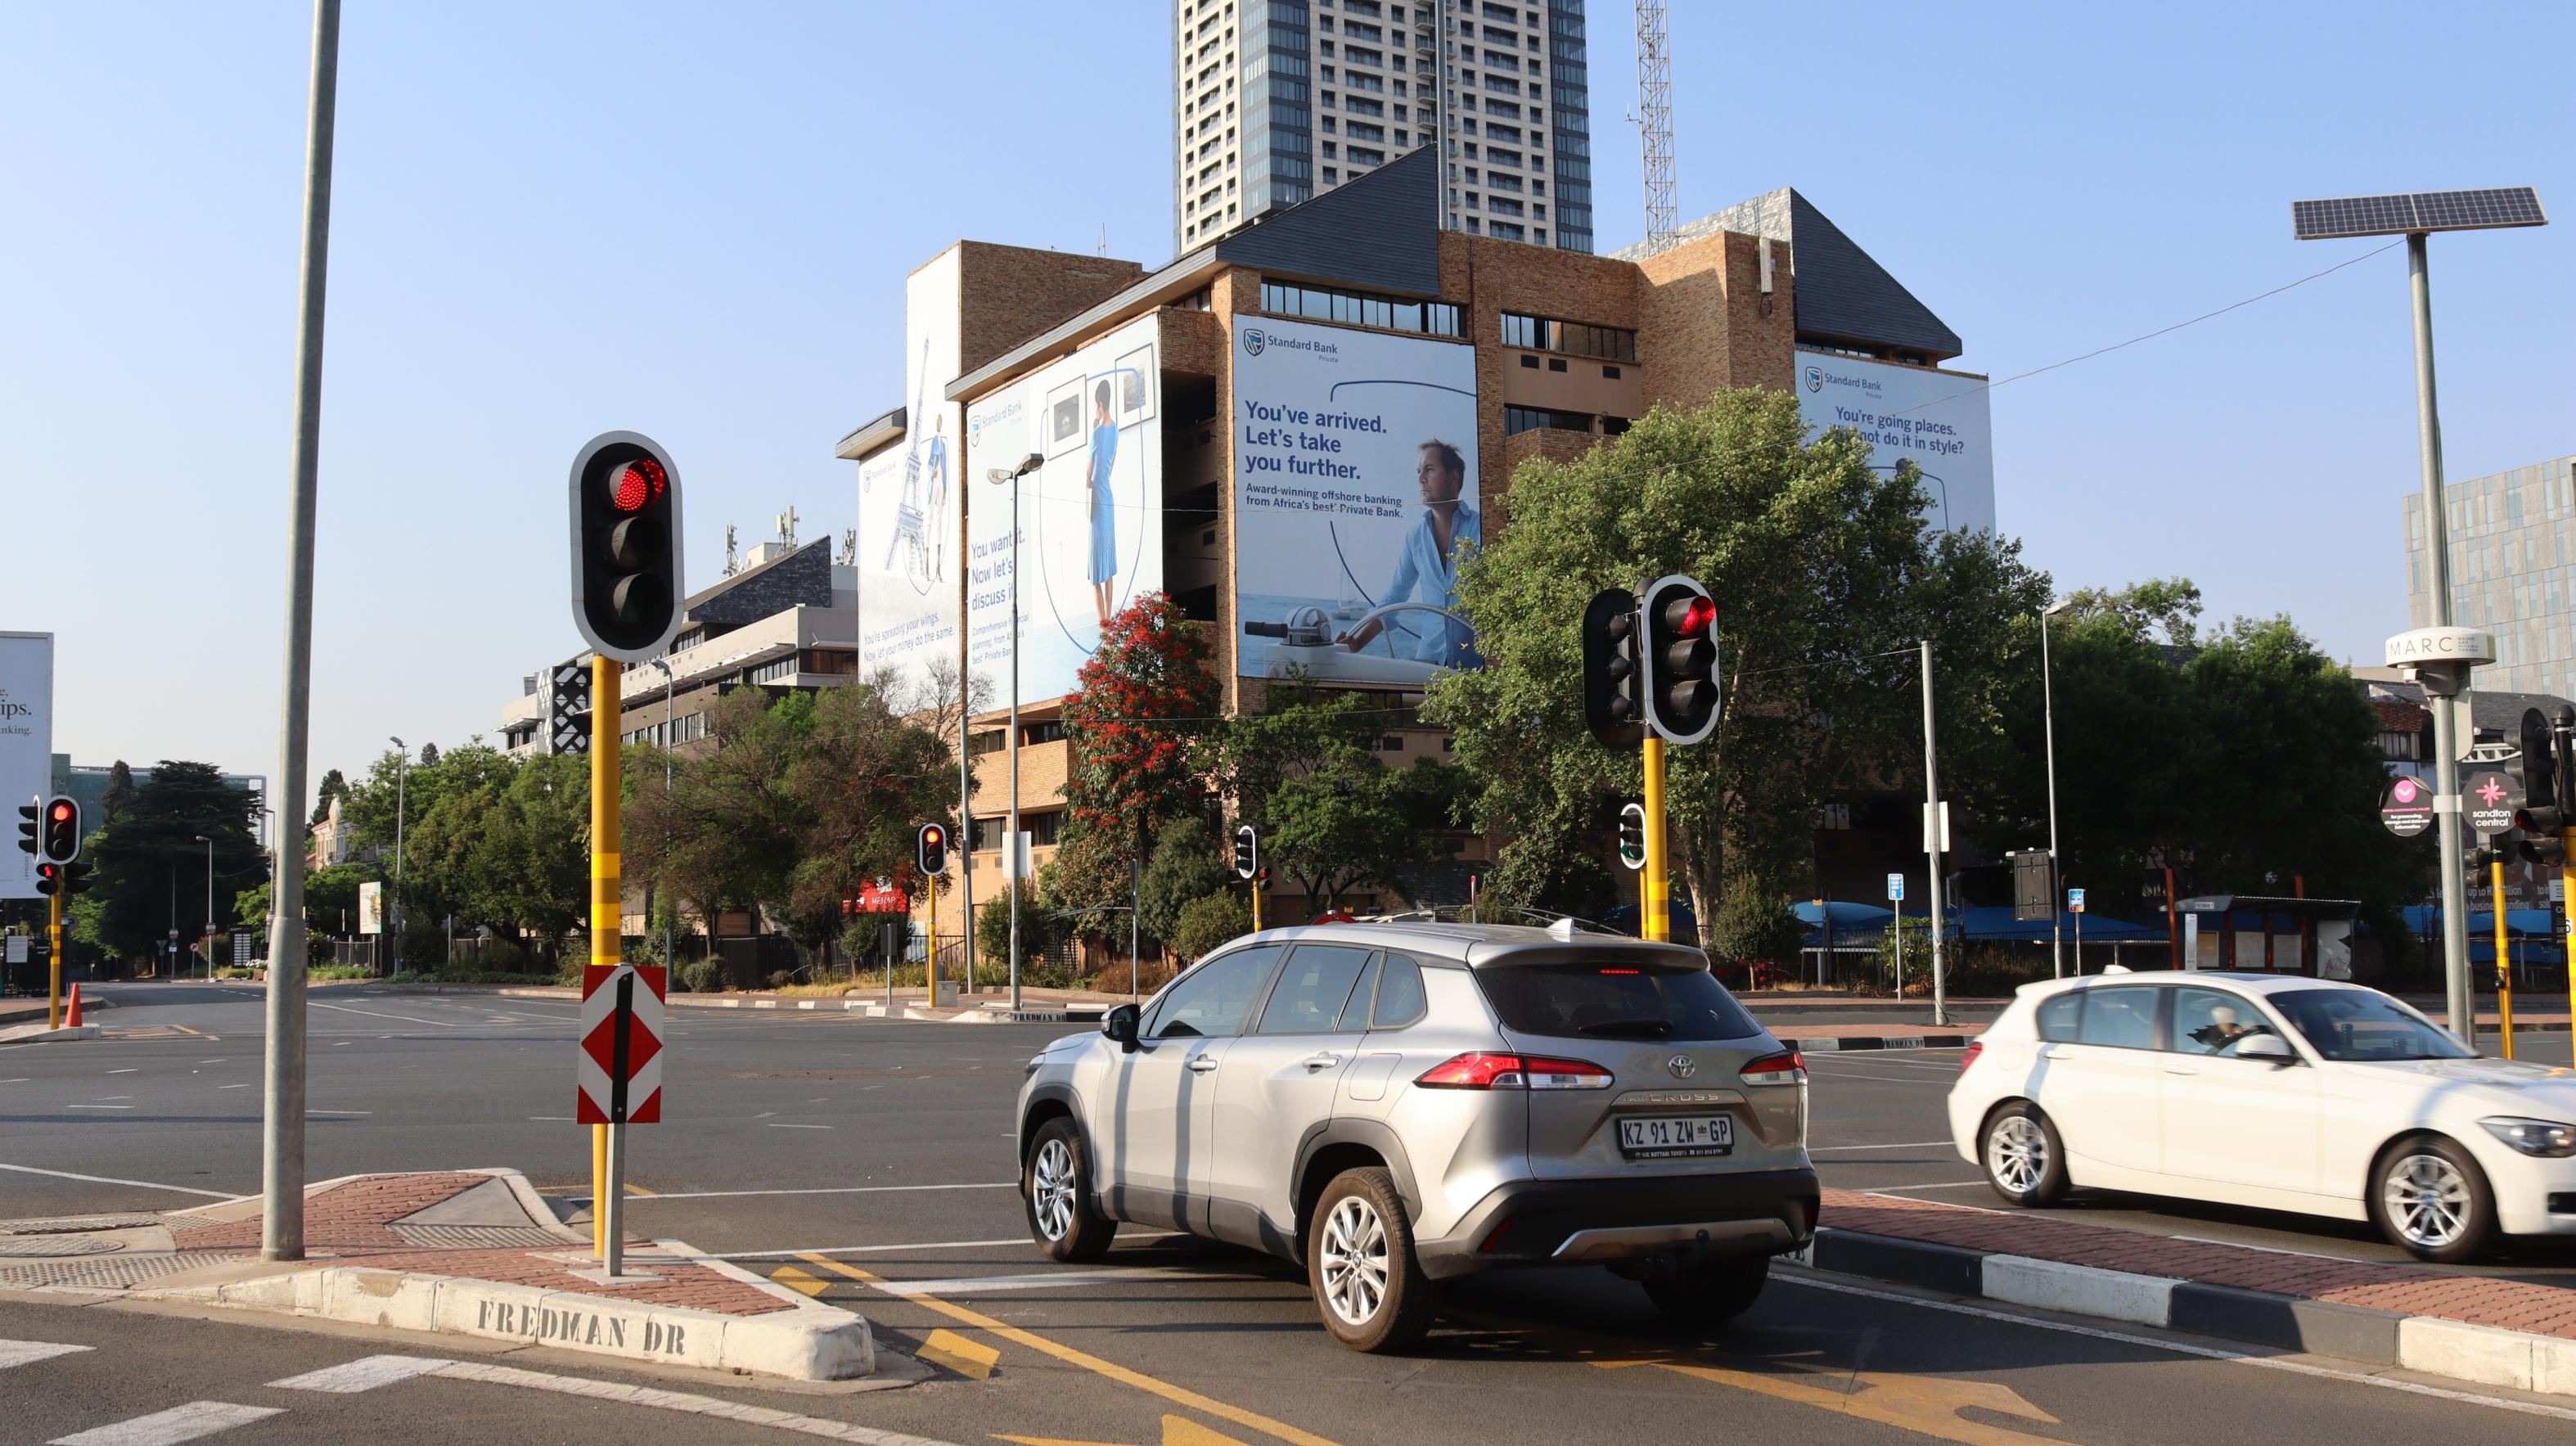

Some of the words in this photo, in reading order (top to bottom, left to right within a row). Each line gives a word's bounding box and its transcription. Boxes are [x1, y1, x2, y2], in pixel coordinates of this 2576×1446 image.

[1268, 336, 1312, 350] Standard
[1314, 341, 1338, 354] Bank
[1318, 354, 1339, 363] Private
[1825, 373, 1860, 388] Standard
[1862, 379, 1881, 391] Bank
[1866, 391, 1882, 399] Private
[982, 406, 1007, 428] Standard
[1007, 399, 1022, 417] Bank
[1245, 399, 1309, 425] You've
[1315, 412, 1387, 434] arrived.
[1835, 405, 1874, 425] You're
[1877, 414, 1912, 433] going
[1915, 418, 1957, 436] places.
[1245, 425, 1294, 448] Let's
[1299, 431, 1342, 453] take
[1860, 430, 1880, 444] not
[1884, 431, 1899, 446] do
[1903, 434, 1912, 448] it
[1915, 435, 1925, 450] in
[1930, 439, 1964, 456] style?
[1245, 455, 1282, 474] you
[1287, 455, 1362, 480] further.
[1245, 483, 1319, 501] Award-winning
[1321, 489, 1362, 503] offshore
[1364, 493, 1403, 508] banking
[1245, 495, 1271, 507] from
[1272, 497, 1310, 511] Africa's
[1340, 503, 1375, 516] Private
[1376, 507, 1403, 519] Bank.
[971, 542, 988, 560] You
[990, 530, 1013, 554] want
[971, 566, 992, 586] Now
[993, 557, 1014, 579] let's
[972, 588, 1007, 611] discuss
[906, 619, 920, 635] your
[921, 612, 940, 627] wings.
[972, 619, 1008, 637] Comprehensive
[864, 651, 876, 663] Now
[885, 644, 897, 660] your
[897, 637, 914, 651] money
[916, 634, 923, 646] do
[925, 630, 935, 643] the
[936, 625, 954, 641] same.
[993, 634, 1007, 646] from
[2389, 636, 2453, 658] MARC
[984, 649, 1002, 662] Private
[2472, 809, 2511, 818] sandton
[2475, 818, 2509, 827] central
[2467, 888, 2477, 899] up
[2504, 885, 2522, 896] illion
[2506, 899, 2529, 911] unding
[1014, 1013, 1053, 1022] FREDMAN
[1649, 1093, 1719, 1102] CROSS
[1624, 1122, 1644, 1145] KZ
[1650, 1121, 1669, 1144] 91
[1674, 1120, 1695, 1143] ZW
[1709, 1119, 1728, 1142] GP
[477, 1299, 628, 1348] FREDMAN
[643, 1321, 686, 1357] DR
